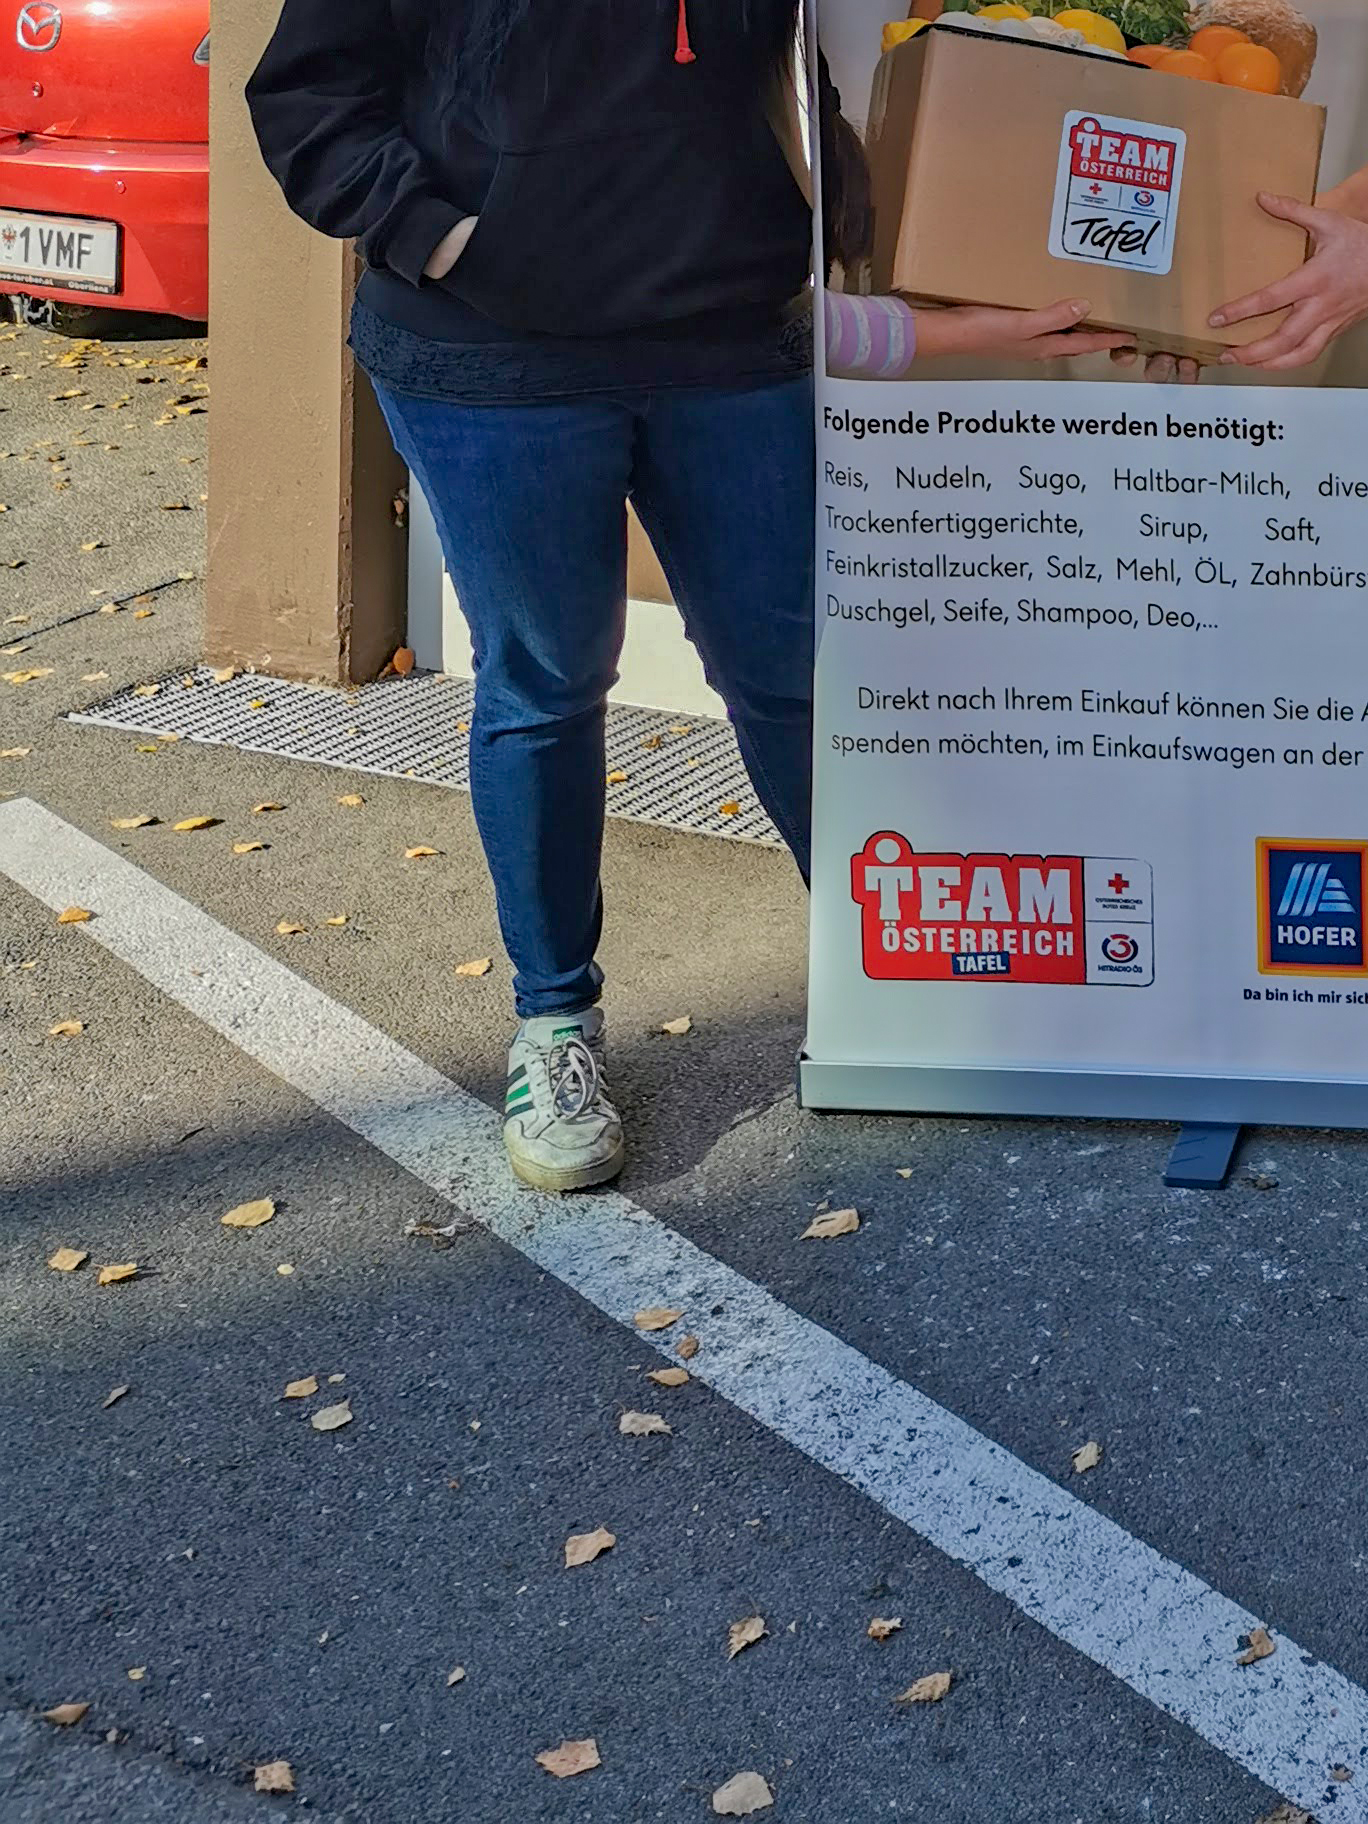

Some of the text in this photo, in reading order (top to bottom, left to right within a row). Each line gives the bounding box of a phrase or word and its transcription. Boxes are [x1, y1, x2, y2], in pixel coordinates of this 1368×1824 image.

[1076, 132, 1169, 171] TEAM
[1080, 158, 1167, 186] ÖSTERREICH
[1071, 218, 1161, 259] Tafel
[823, 406, 1284, 447] Folgende Produkte werden benötigt:
[824, 460, 869, 493] Reis,
[896, 464, 992, 492] Nudeln,
[1018, 464, 1087, 496] Sugo,
[1114, 467, 1291, 500] Haltbar-Milch,
[824, 504, 1084, 540] Trockenfertiggerichte,
[1139, 513, 1208, 545] Sirup,
[1264, 516, 1321, 546] Saft,
[826, 549, 1033, 582] Feinkristallzucker,
[1046, 554, 1103, 584] Salz,
[1116, 557, 1182, 587] Mehl,
[826, 593, 936, 629] Duschgel,
[943, 597, 1009, 626] Seife,
[1016, 598, 1139, 630] Shampoo,
[858, 686, 930, 711] Direkt
[937, 686, 996, 710] nach
[1004, 686, 1073, 712] Ihrem
[1081, 689, 1170, 716] Einkauf
[1176, 692, 1265, 720] können
[1272, 696, 1310, 721] Sie
[1316, 696, 1354, 722] die
[831, 730, 930, 757] spenden
[938, 730, 1049, 759] möchten,
[1056, 734, 1084, 756] im
[1092, 733, 1275, 770] Einkaufswagen
[1283, 748, 1314, 765] an
[1321, 741, 1365, 767] der
[865, 866, 1073, 924] TEAM
[882, 921, 1073, 956] ÖSTERREICH
[1277, 925, 1357, 947] HOFER
[956, 956, 1006, 972] TAFEL
[1243, 988, 1261, 1001] Da
[1266, 988, 1289, 1002] bin
[1293, 989, 1314, 1003] ich
[1318, 990, 1342, 1004] mir
